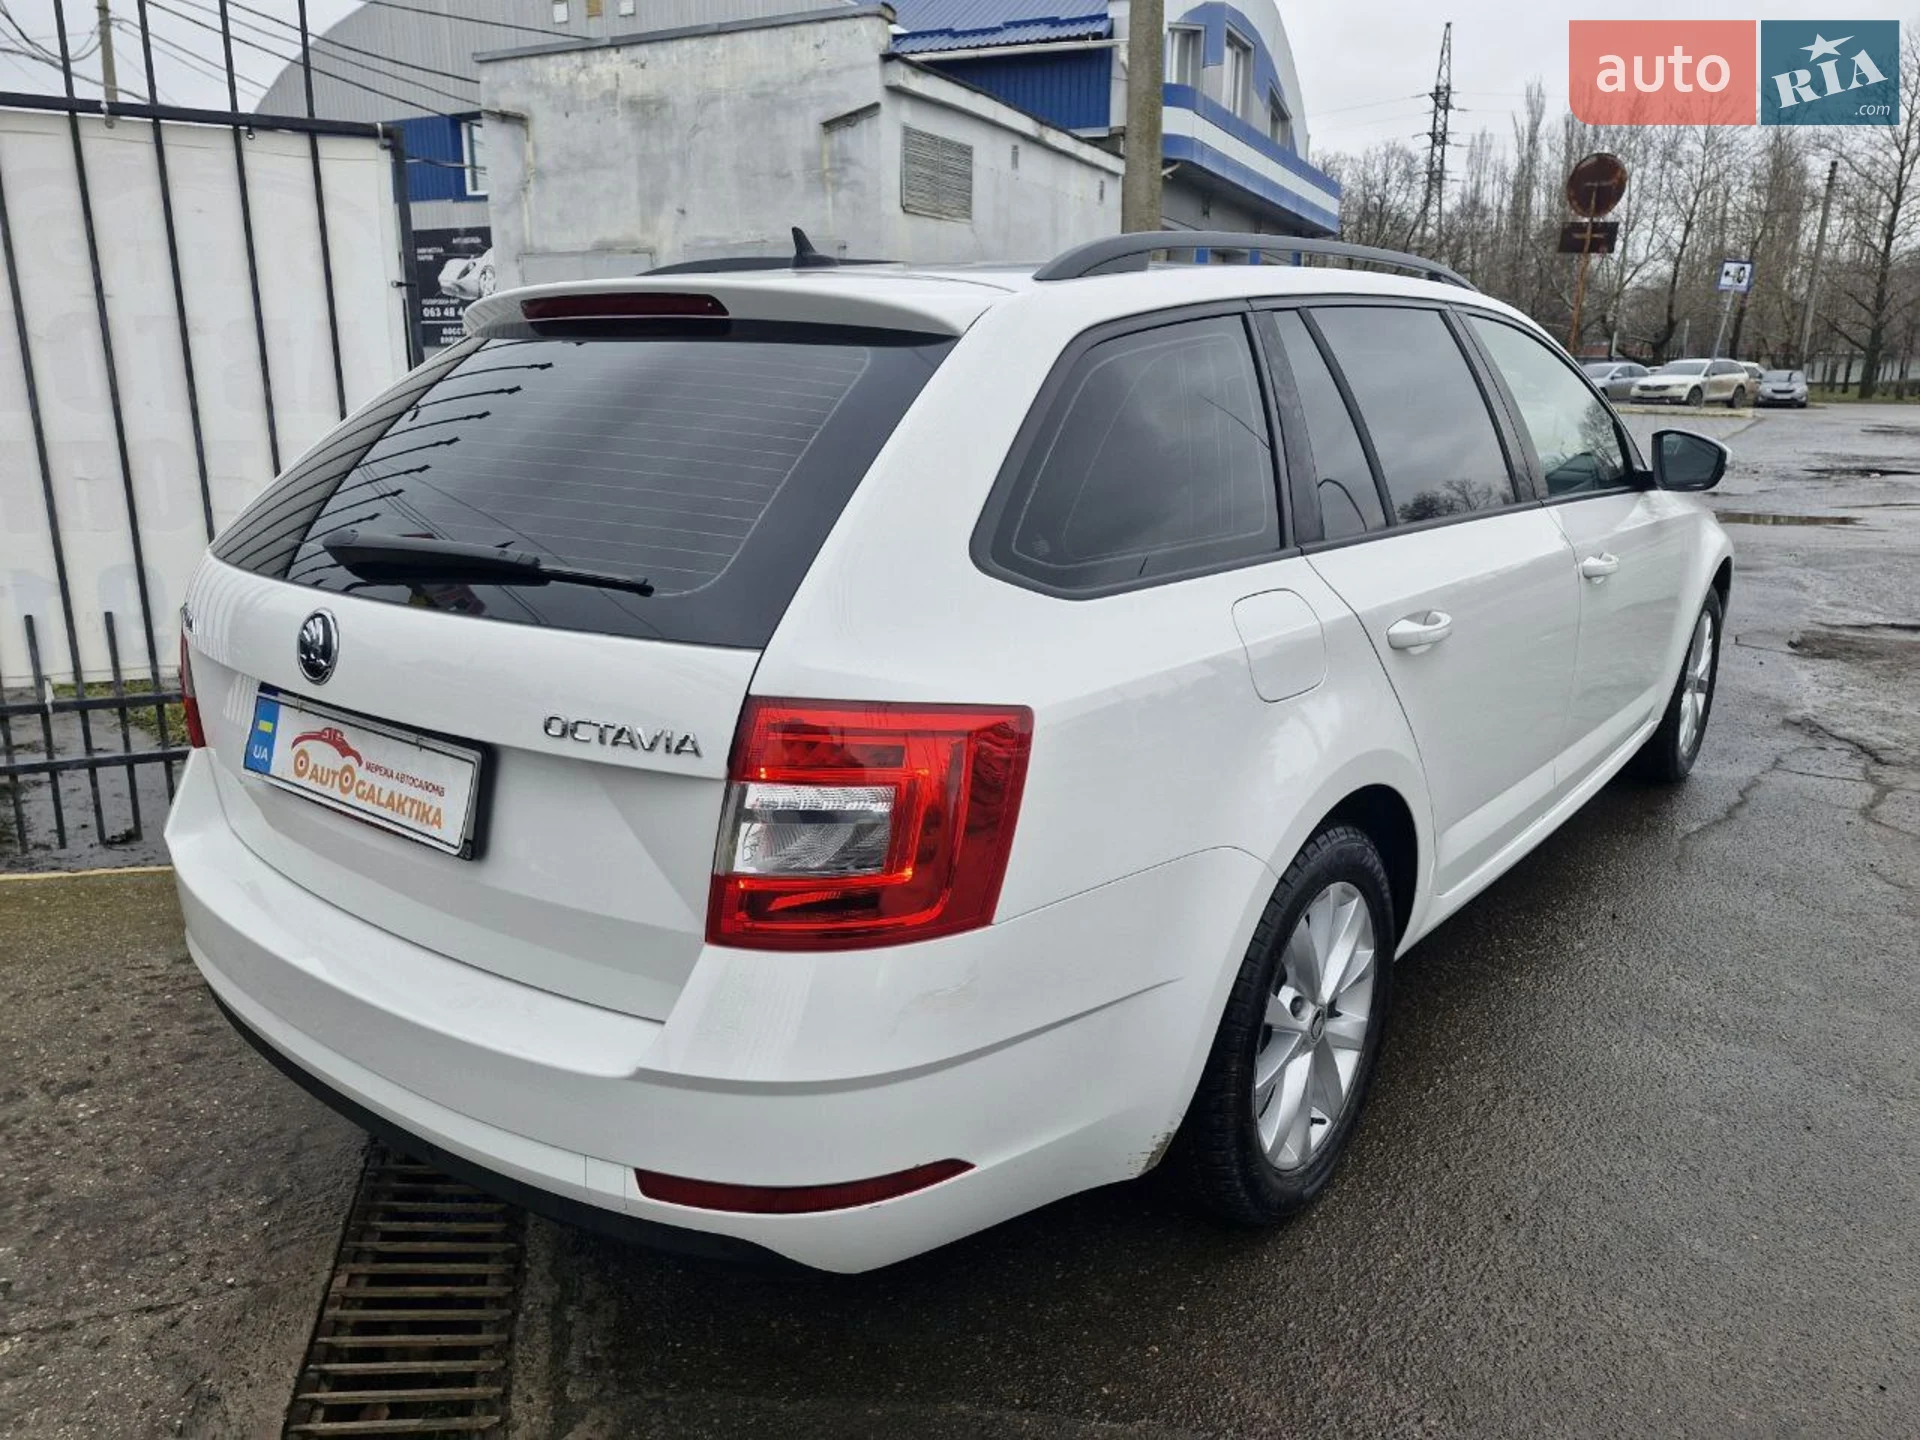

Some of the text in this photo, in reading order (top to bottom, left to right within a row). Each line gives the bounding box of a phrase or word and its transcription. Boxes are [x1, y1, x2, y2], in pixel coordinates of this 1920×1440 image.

[422, 307, 441, 317] 063
[543, 714, 703, 758] OCTAVIA
[252, 745, 269, 761] UA
[364, 760, 395, 781] МЕРЕЖА
